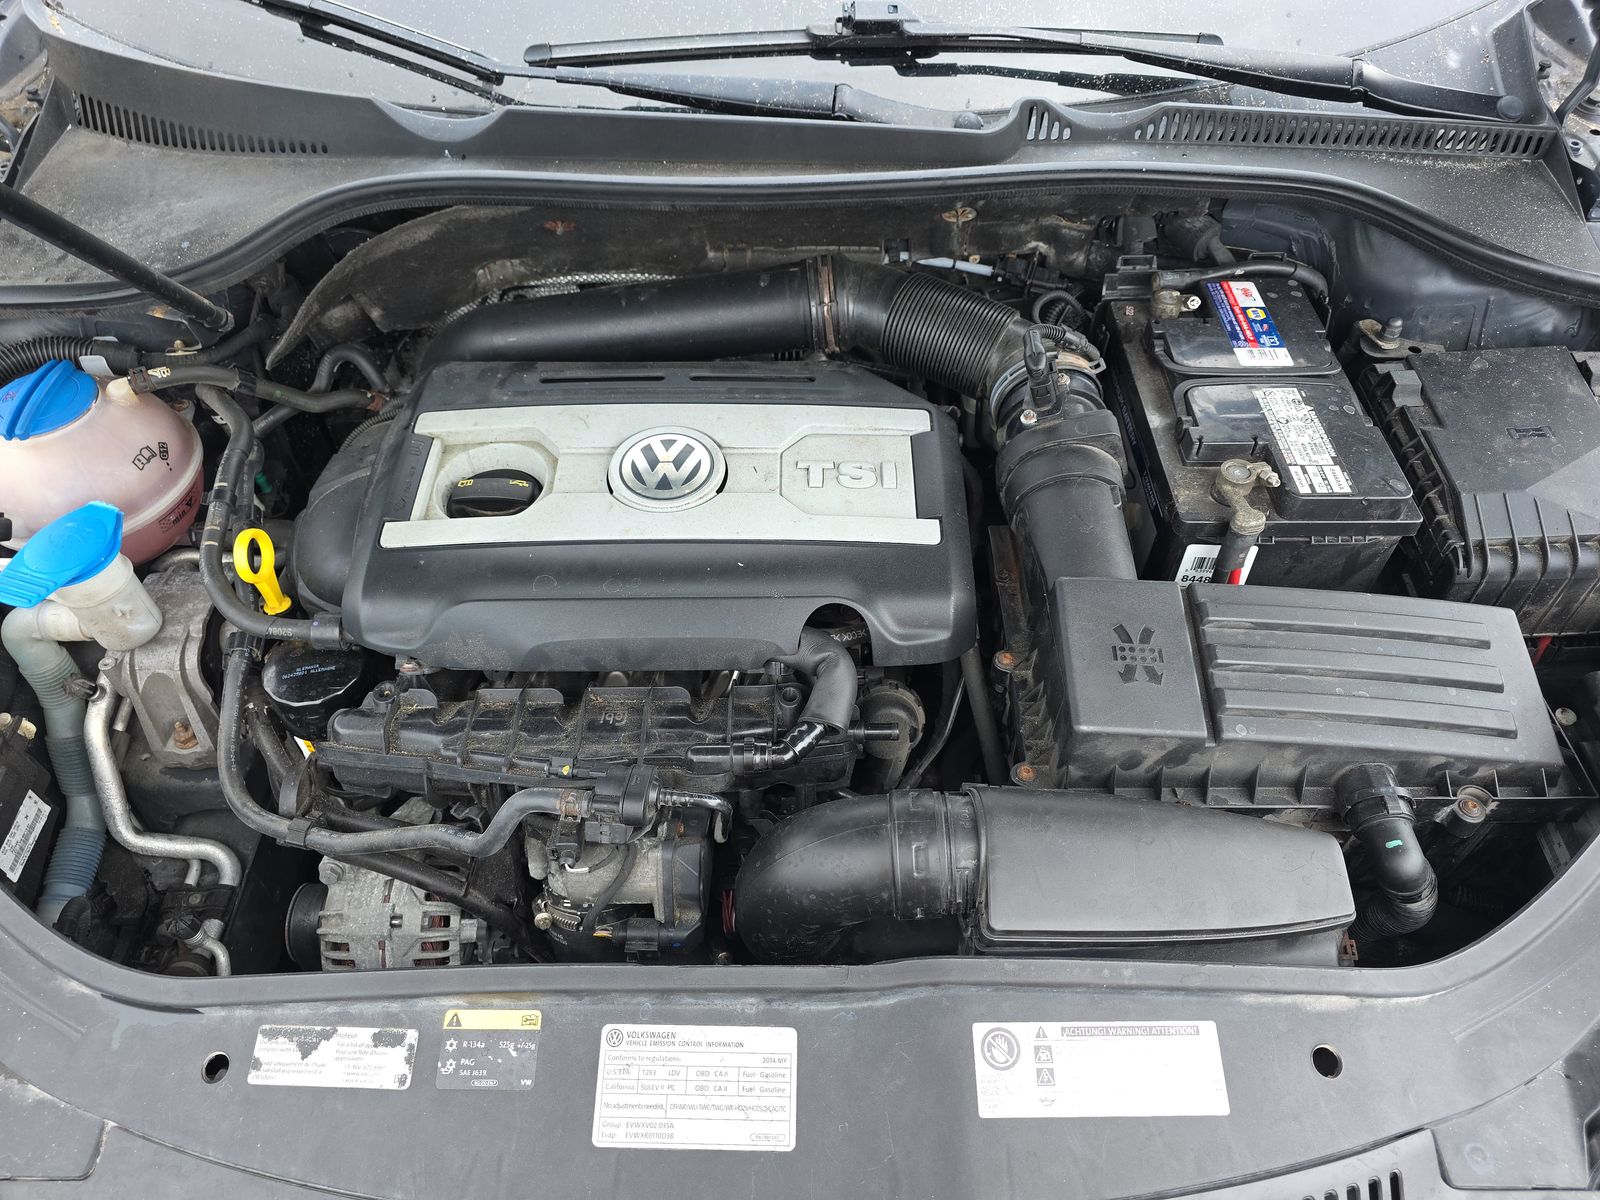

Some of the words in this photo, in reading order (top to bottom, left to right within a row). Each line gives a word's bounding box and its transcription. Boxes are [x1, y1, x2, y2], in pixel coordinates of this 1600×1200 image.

[159, 442, 168, 460] G12
[796, 460, 898, 489] TSI
[172, 510, 187, 525] min
[1181, 575, 1211, 583] 8448
[599, 711, 628, 726] febi
[960, 807, 971, 829] TOP
[627, 1031, 676, 1039] VOLKSWAGEN
[1065, 1027, 1106, 1036] ACHTUNG!
[1108, 1026, 1149, 1036] WARNING!
[1152, 1026, 1197, 1035] ATTENTION!
[498, 1041, 515, 1049] 525g
[460, 1058, 475, 1066] PAG
[760, 1071, 786, 1079] Gasoline
[667, 1084, 676, 1092] PC
[759, 1086, 786, 1094] Gasoline
[610, 1103, 643, 1111] adjustments
